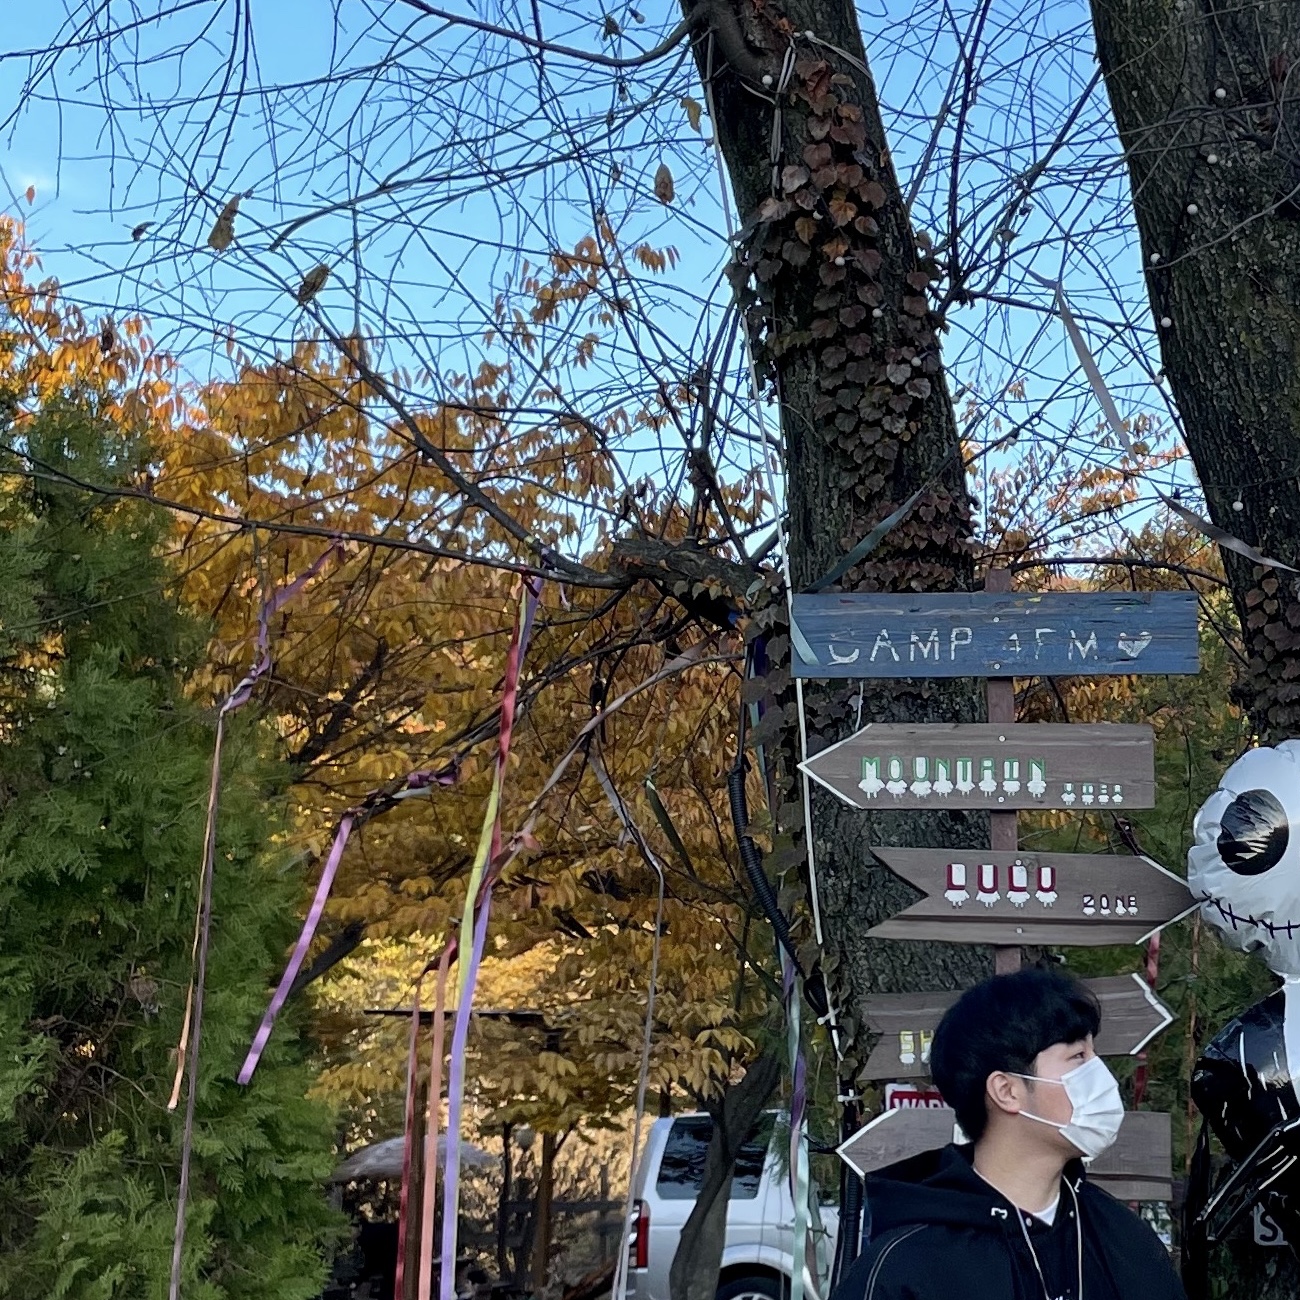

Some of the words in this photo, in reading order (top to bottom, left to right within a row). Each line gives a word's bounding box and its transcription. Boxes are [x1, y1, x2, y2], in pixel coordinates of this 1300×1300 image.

[828, 626, 973, 667] CAMP
[859, 755, 1047, 785] MOUNTAIN
[946, 863, 1057, 894] LULU
[1082, 893, 1138, 911] ZONE
